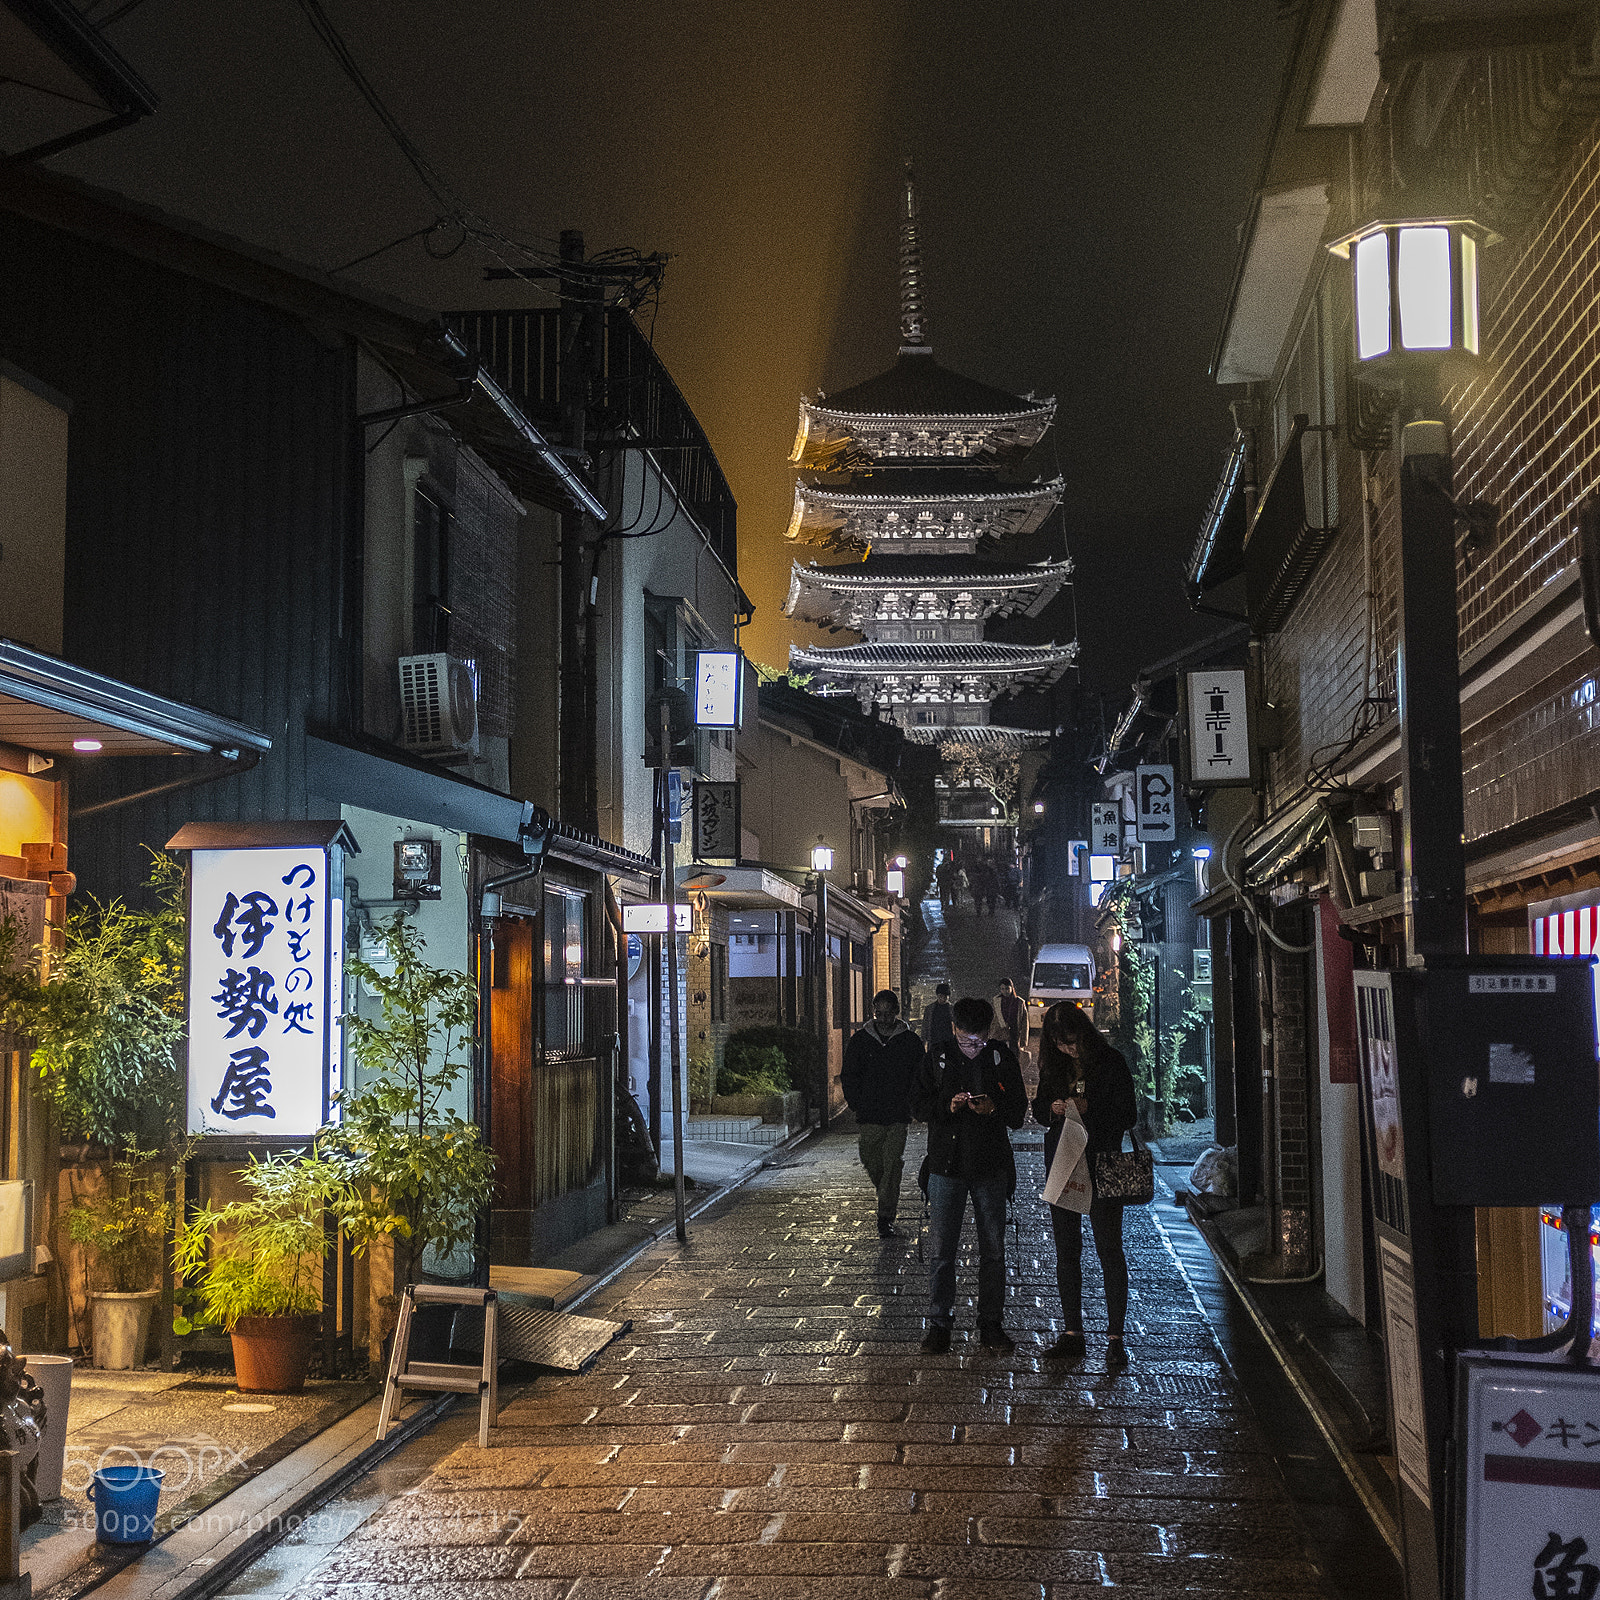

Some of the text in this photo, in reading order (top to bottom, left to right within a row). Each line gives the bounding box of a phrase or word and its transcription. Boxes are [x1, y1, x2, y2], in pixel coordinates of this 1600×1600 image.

[1152, 803, 1171, 815] 24
[211, 890, 279, 1120] 伊勢屋
[282, 864, 316, 1034] つけもの処
